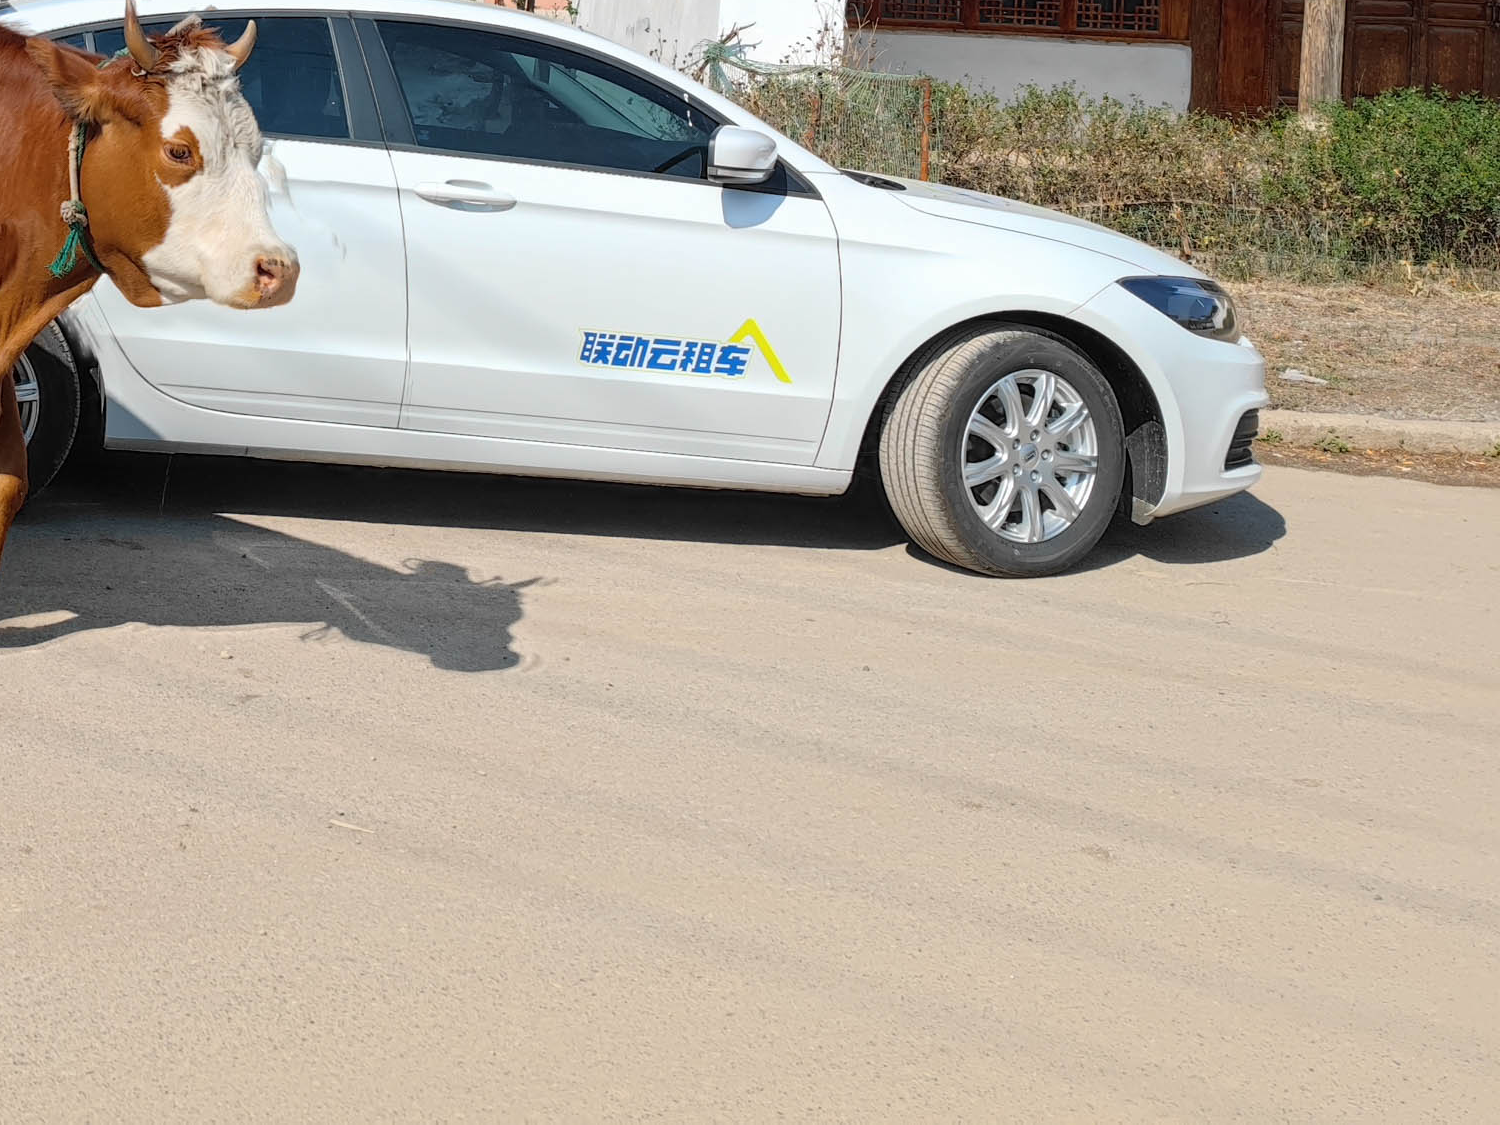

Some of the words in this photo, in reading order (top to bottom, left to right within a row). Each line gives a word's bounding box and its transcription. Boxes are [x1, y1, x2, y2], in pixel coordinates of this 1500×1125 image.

[580, 332, 750, 375] 联动云租车
